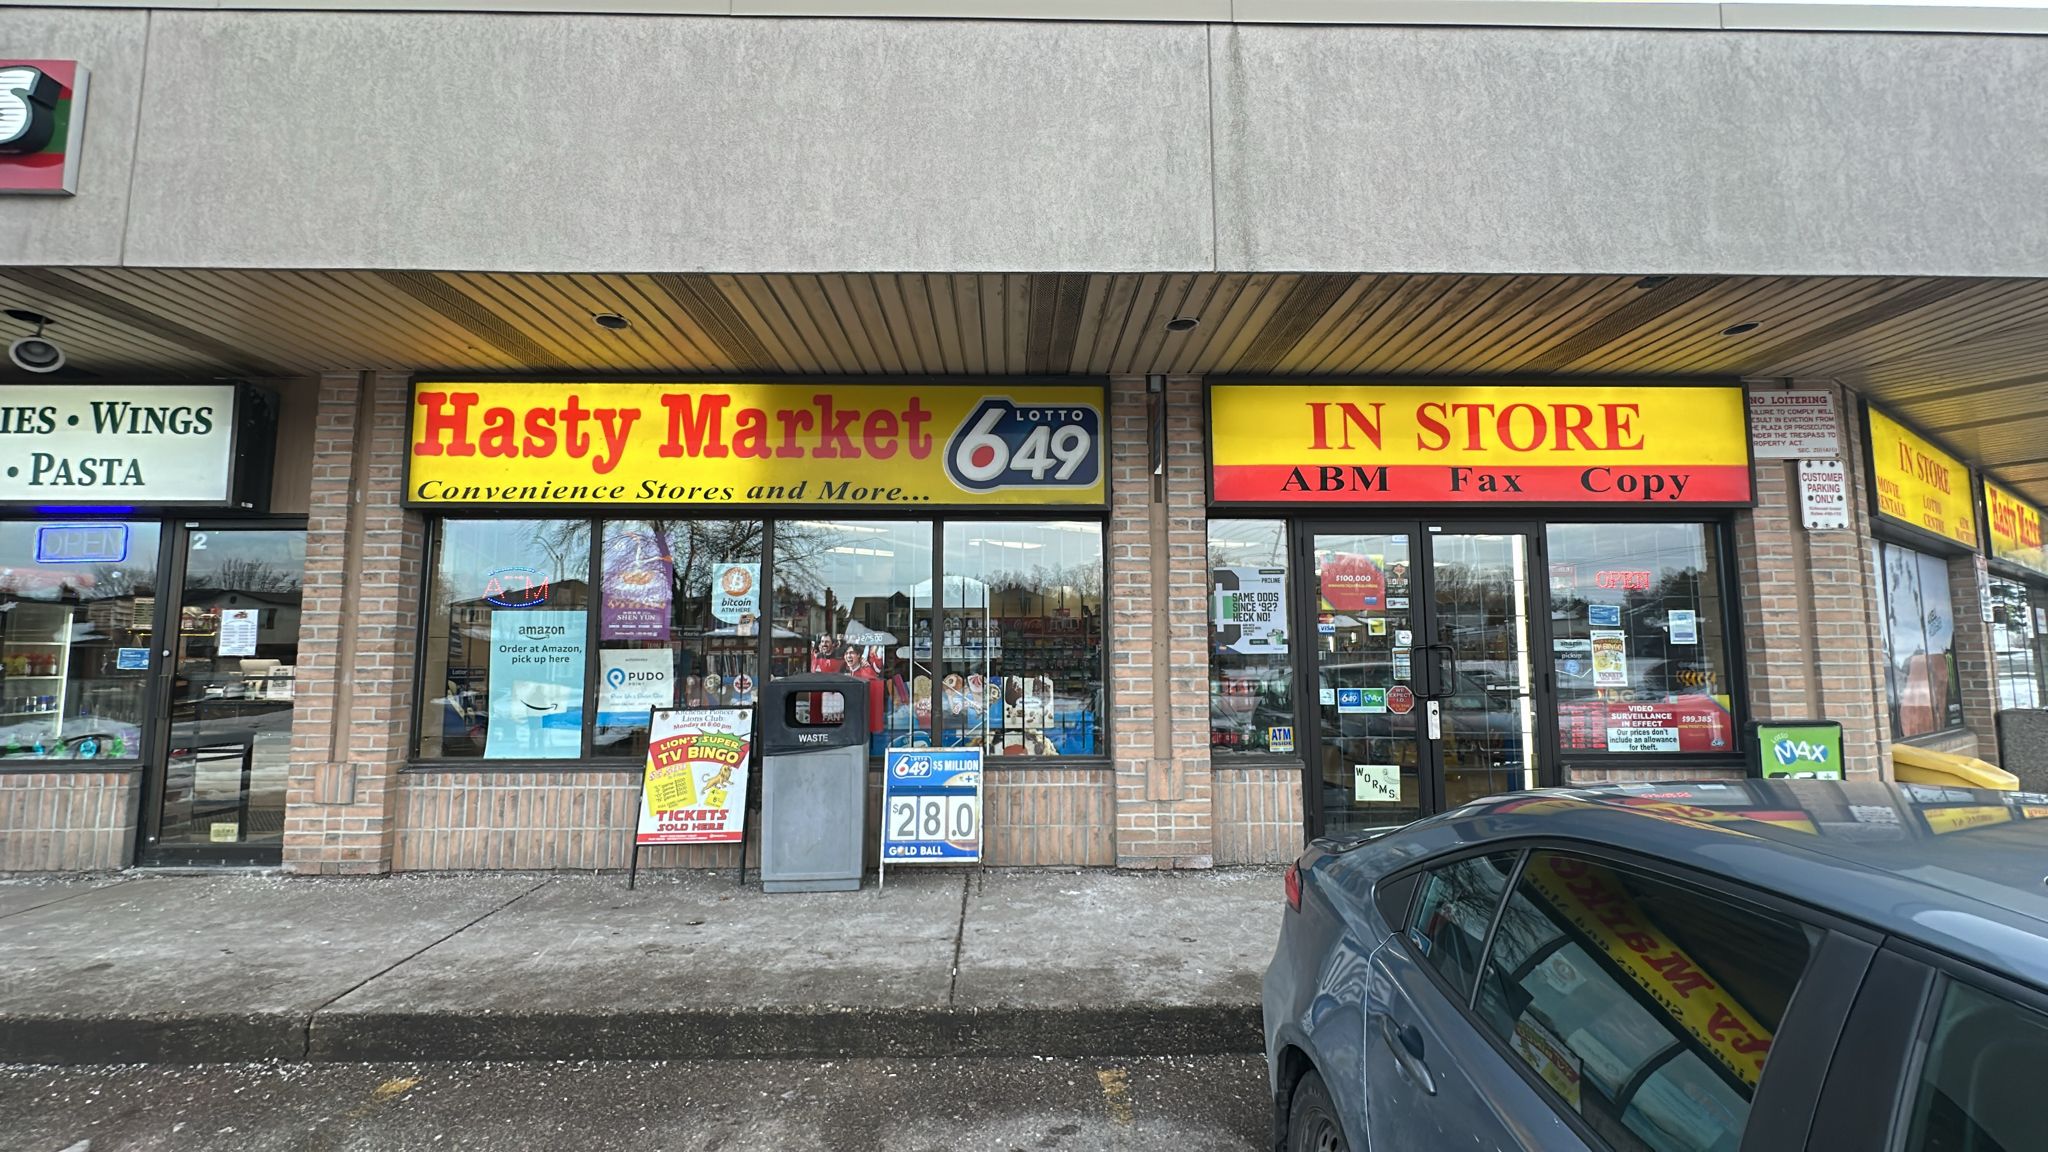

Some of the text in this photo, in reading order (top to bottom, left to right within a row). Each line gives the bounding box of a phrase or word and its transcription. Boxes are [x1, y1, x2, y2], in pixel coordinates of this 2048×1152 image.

[1771, 396, 1827, 404] LOITERING
[1016, 410, 1084, 422] LOTTO
[1306, 402, 1645, 452] IN STORE
[413, 391, 933, 475] Hasty Market
[1898, 440, 1951, 496] IN STORE
[1802, 473, 1843, 482] CUSTOMER
[1280, 466, 1690, 501] ABM Fax Copy
[1807, 484, 1840, 493] PARKING
[417, 479, 931, 501] Convenience Stores and More...
[1815, 495, 1834, 503] ONLY
[44, 530, 118, 558] OPEN
[192, 533, 208, 550] 2
[1595, 571, 1651, 590] OPEN
[481, 576, 549, 600] ATM
[721, 598, 751, 607] bitcoin
[1232, 592, 1279, 602] SAME ODDS
[1232, 602, 1256, 612] SINCE
[1232, 612, 1271, 622] HECK NO!
[518, 625, 565, 637] amazon
[499, 644, 582, 655] Order at Amazon,
[511, 654, 570, 665] pick up here
[628, 672, 664, 681] PUDO
[1341, 693, 1358, 703] 649
[673, 722, 699, 730] Monday
[798, 734, 829, 743] WASTE
[1271, 728, 1291, 740] ATM
[1630, 729, 1650, 738] prices
[661, 735, 739, 751] LION'S SUPER
[658, 746, 739, 766] TV BINGO
[1774, 739, 1826, 765] MAX
[895, 757, 978, 776] 649 $5 MILLION
[656, 809, 729, 822] TICKETS
[657, 823, 724, 832] SOLD HERE
[920, 846, 943, 855] BALL
